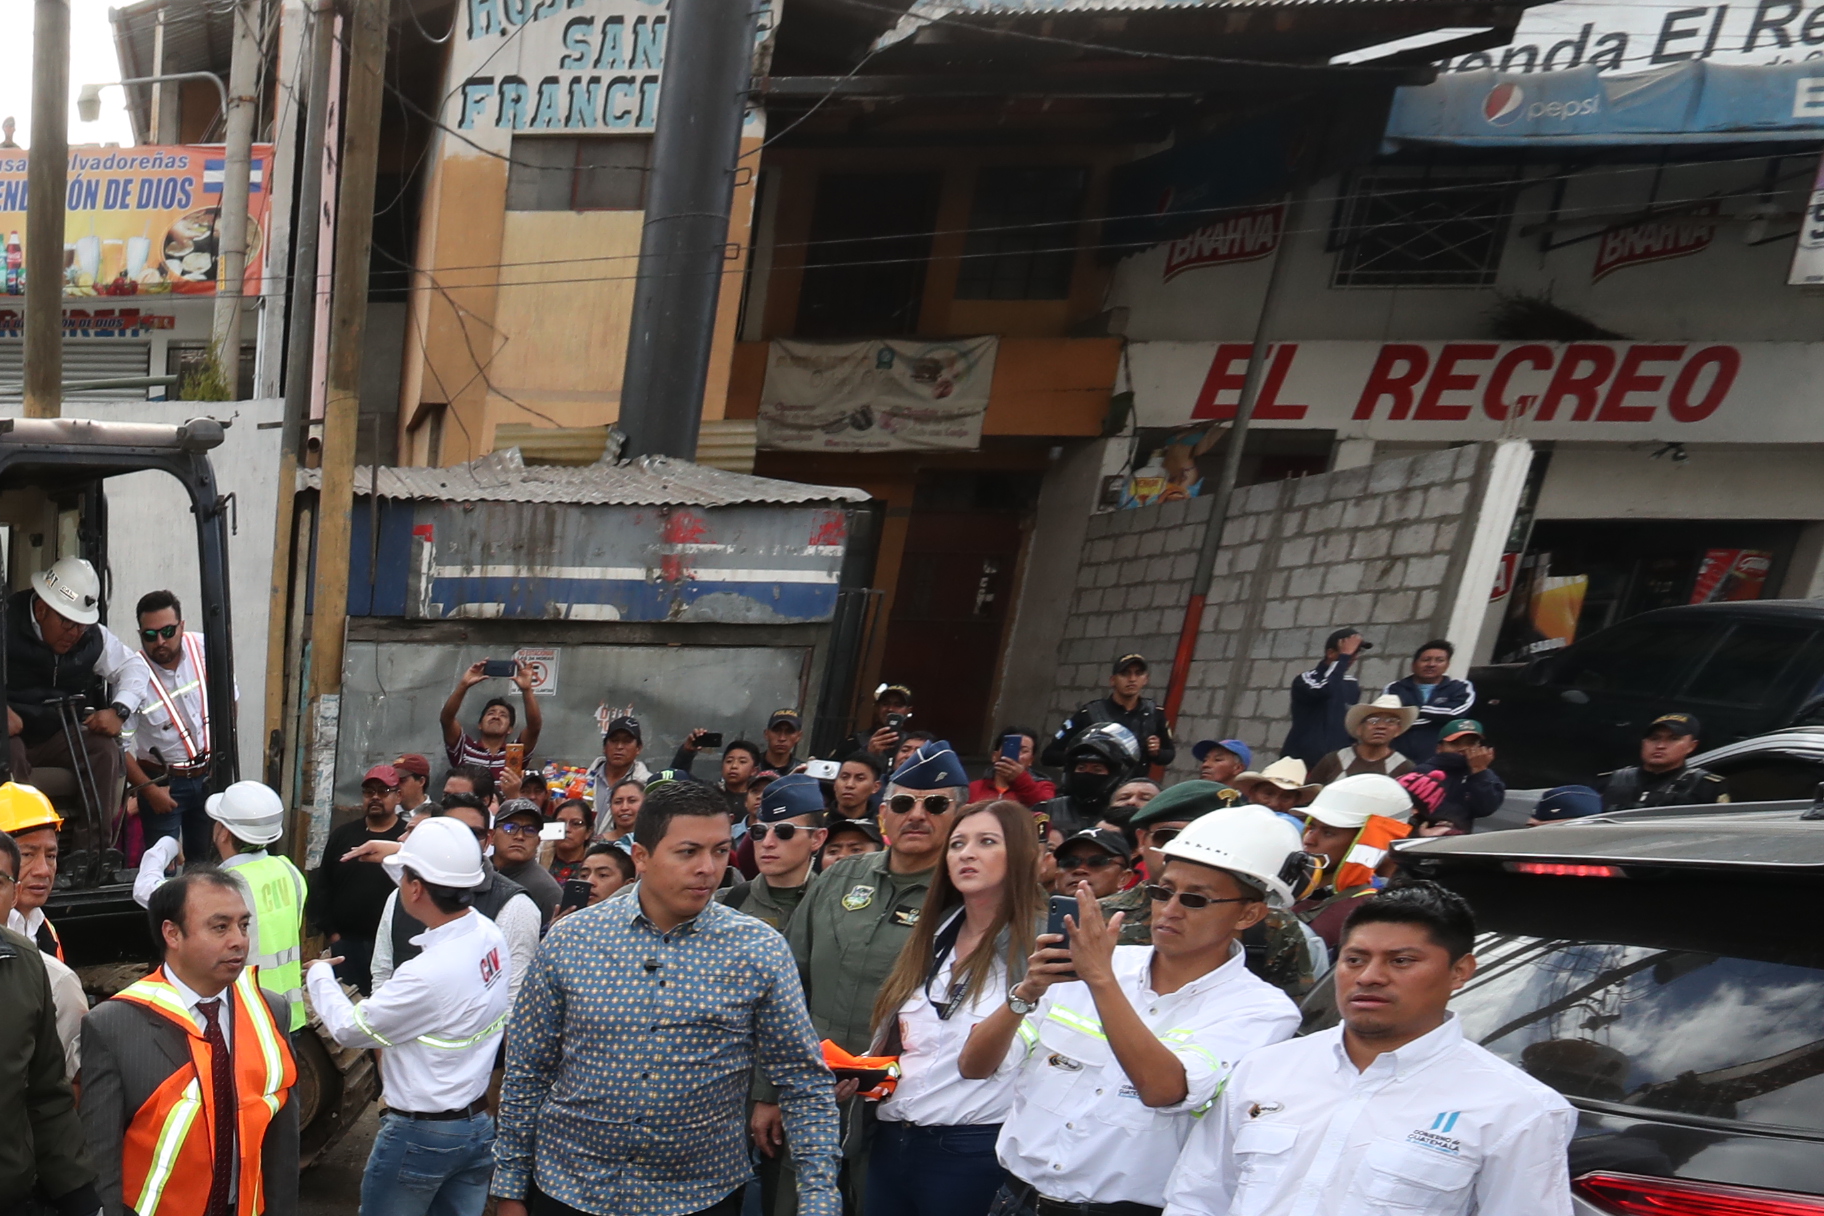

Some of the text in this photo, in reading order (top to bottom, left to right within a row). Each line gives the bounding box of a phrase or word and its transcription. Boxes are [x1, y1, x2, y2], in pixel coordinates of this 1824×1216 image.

[560, 15, 668, 70] SAN
[1650, 4, 1729, 65] El
[1743, 0, 1824, 54] Re
[1527, 95, 1600, 121] pepsi
[102, 179, 133, 211] DE
[136, 176, 195, 209] DIOS
[79, 318, 94, 328] DE
[95, 318, 125, 328] DIOS
[1191, 343, 1742, 423] EL RECREO
[261, 877, 291, 912] CIV
[480, 946, 501, 983] CIV
[1407, 1133, 1460, 1151] GUATEMALA
